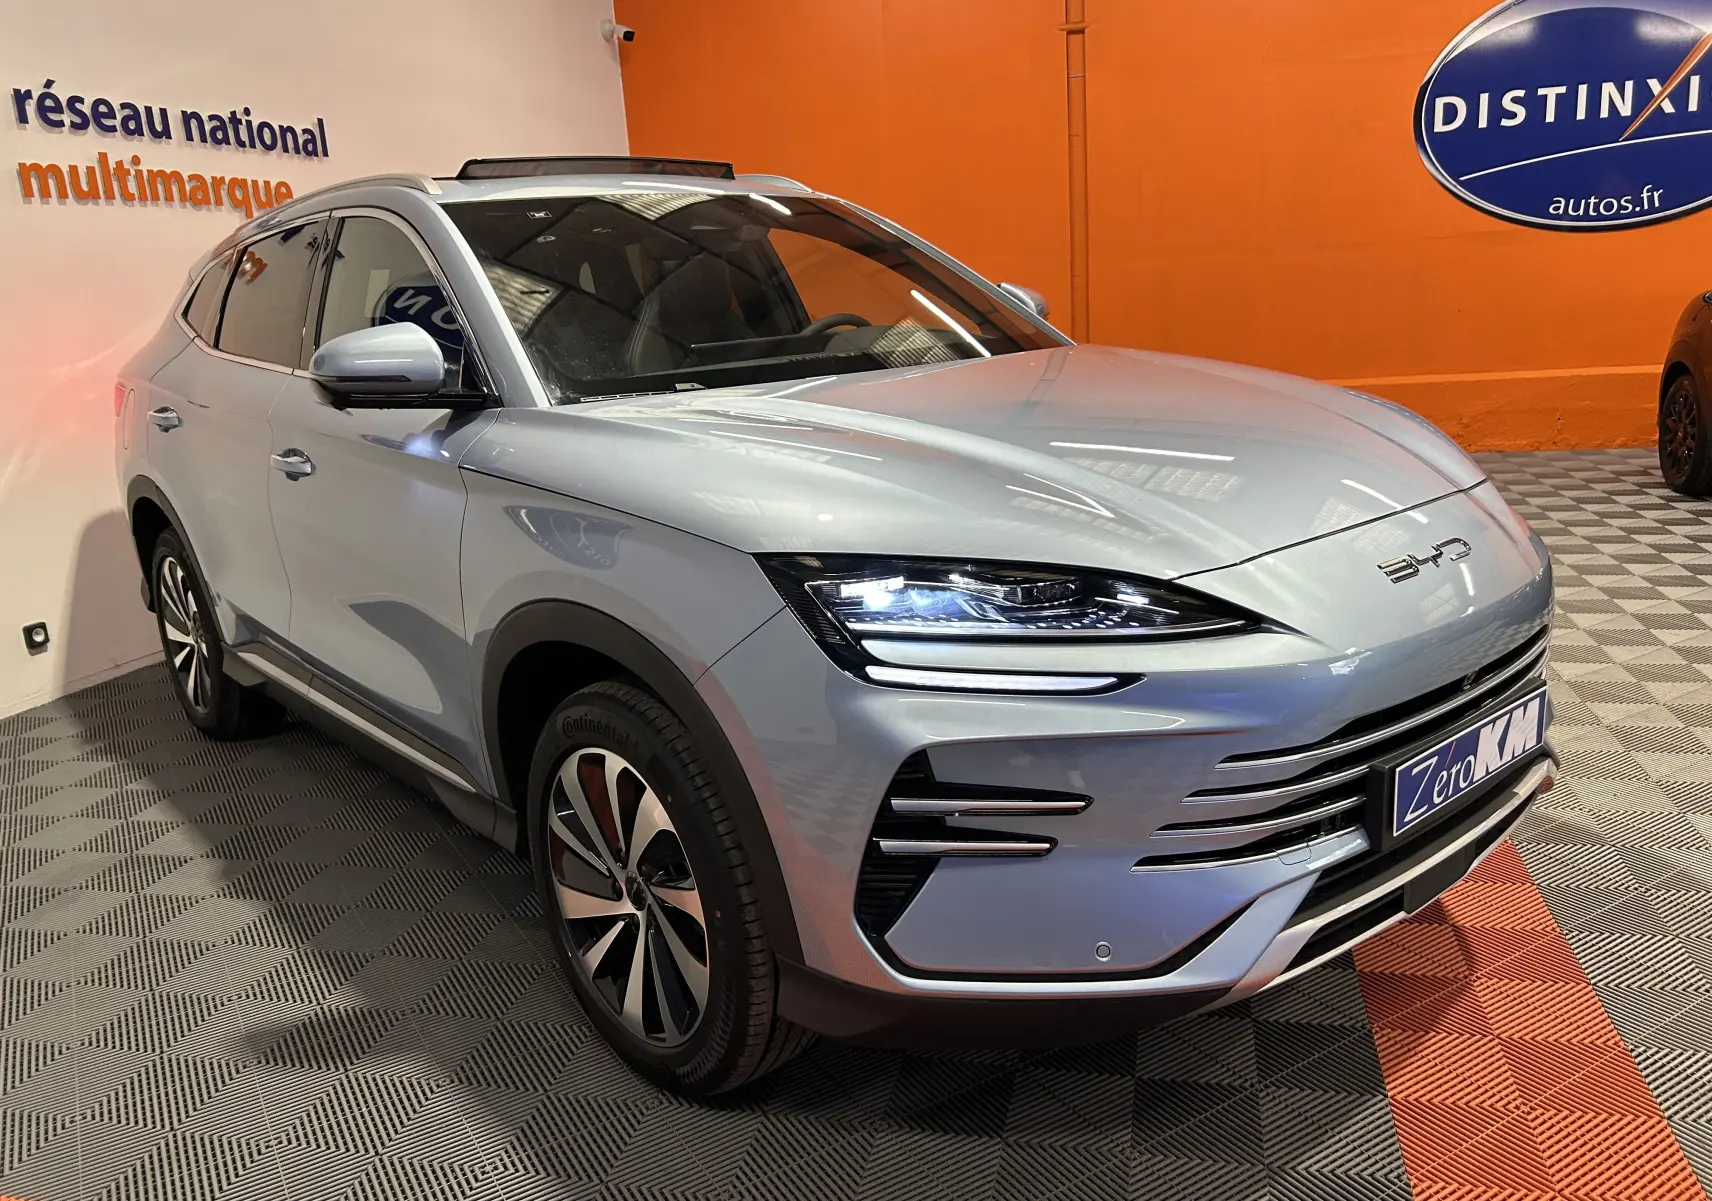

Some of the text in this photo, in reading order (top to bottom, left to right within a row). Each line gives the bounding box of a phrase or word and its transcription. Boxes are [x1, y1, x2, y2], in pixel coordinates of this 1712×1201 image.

[12, 78, 330, 158] réseau national
[1433, 75, 1712, 133] DISTINXI
[18, 151, 294, 219] multimarque
[1548, 184, 1664, 217] autos.fr
[1376, 536, 1472, 584] BYD
[562, 712, 630, 749] Continental
